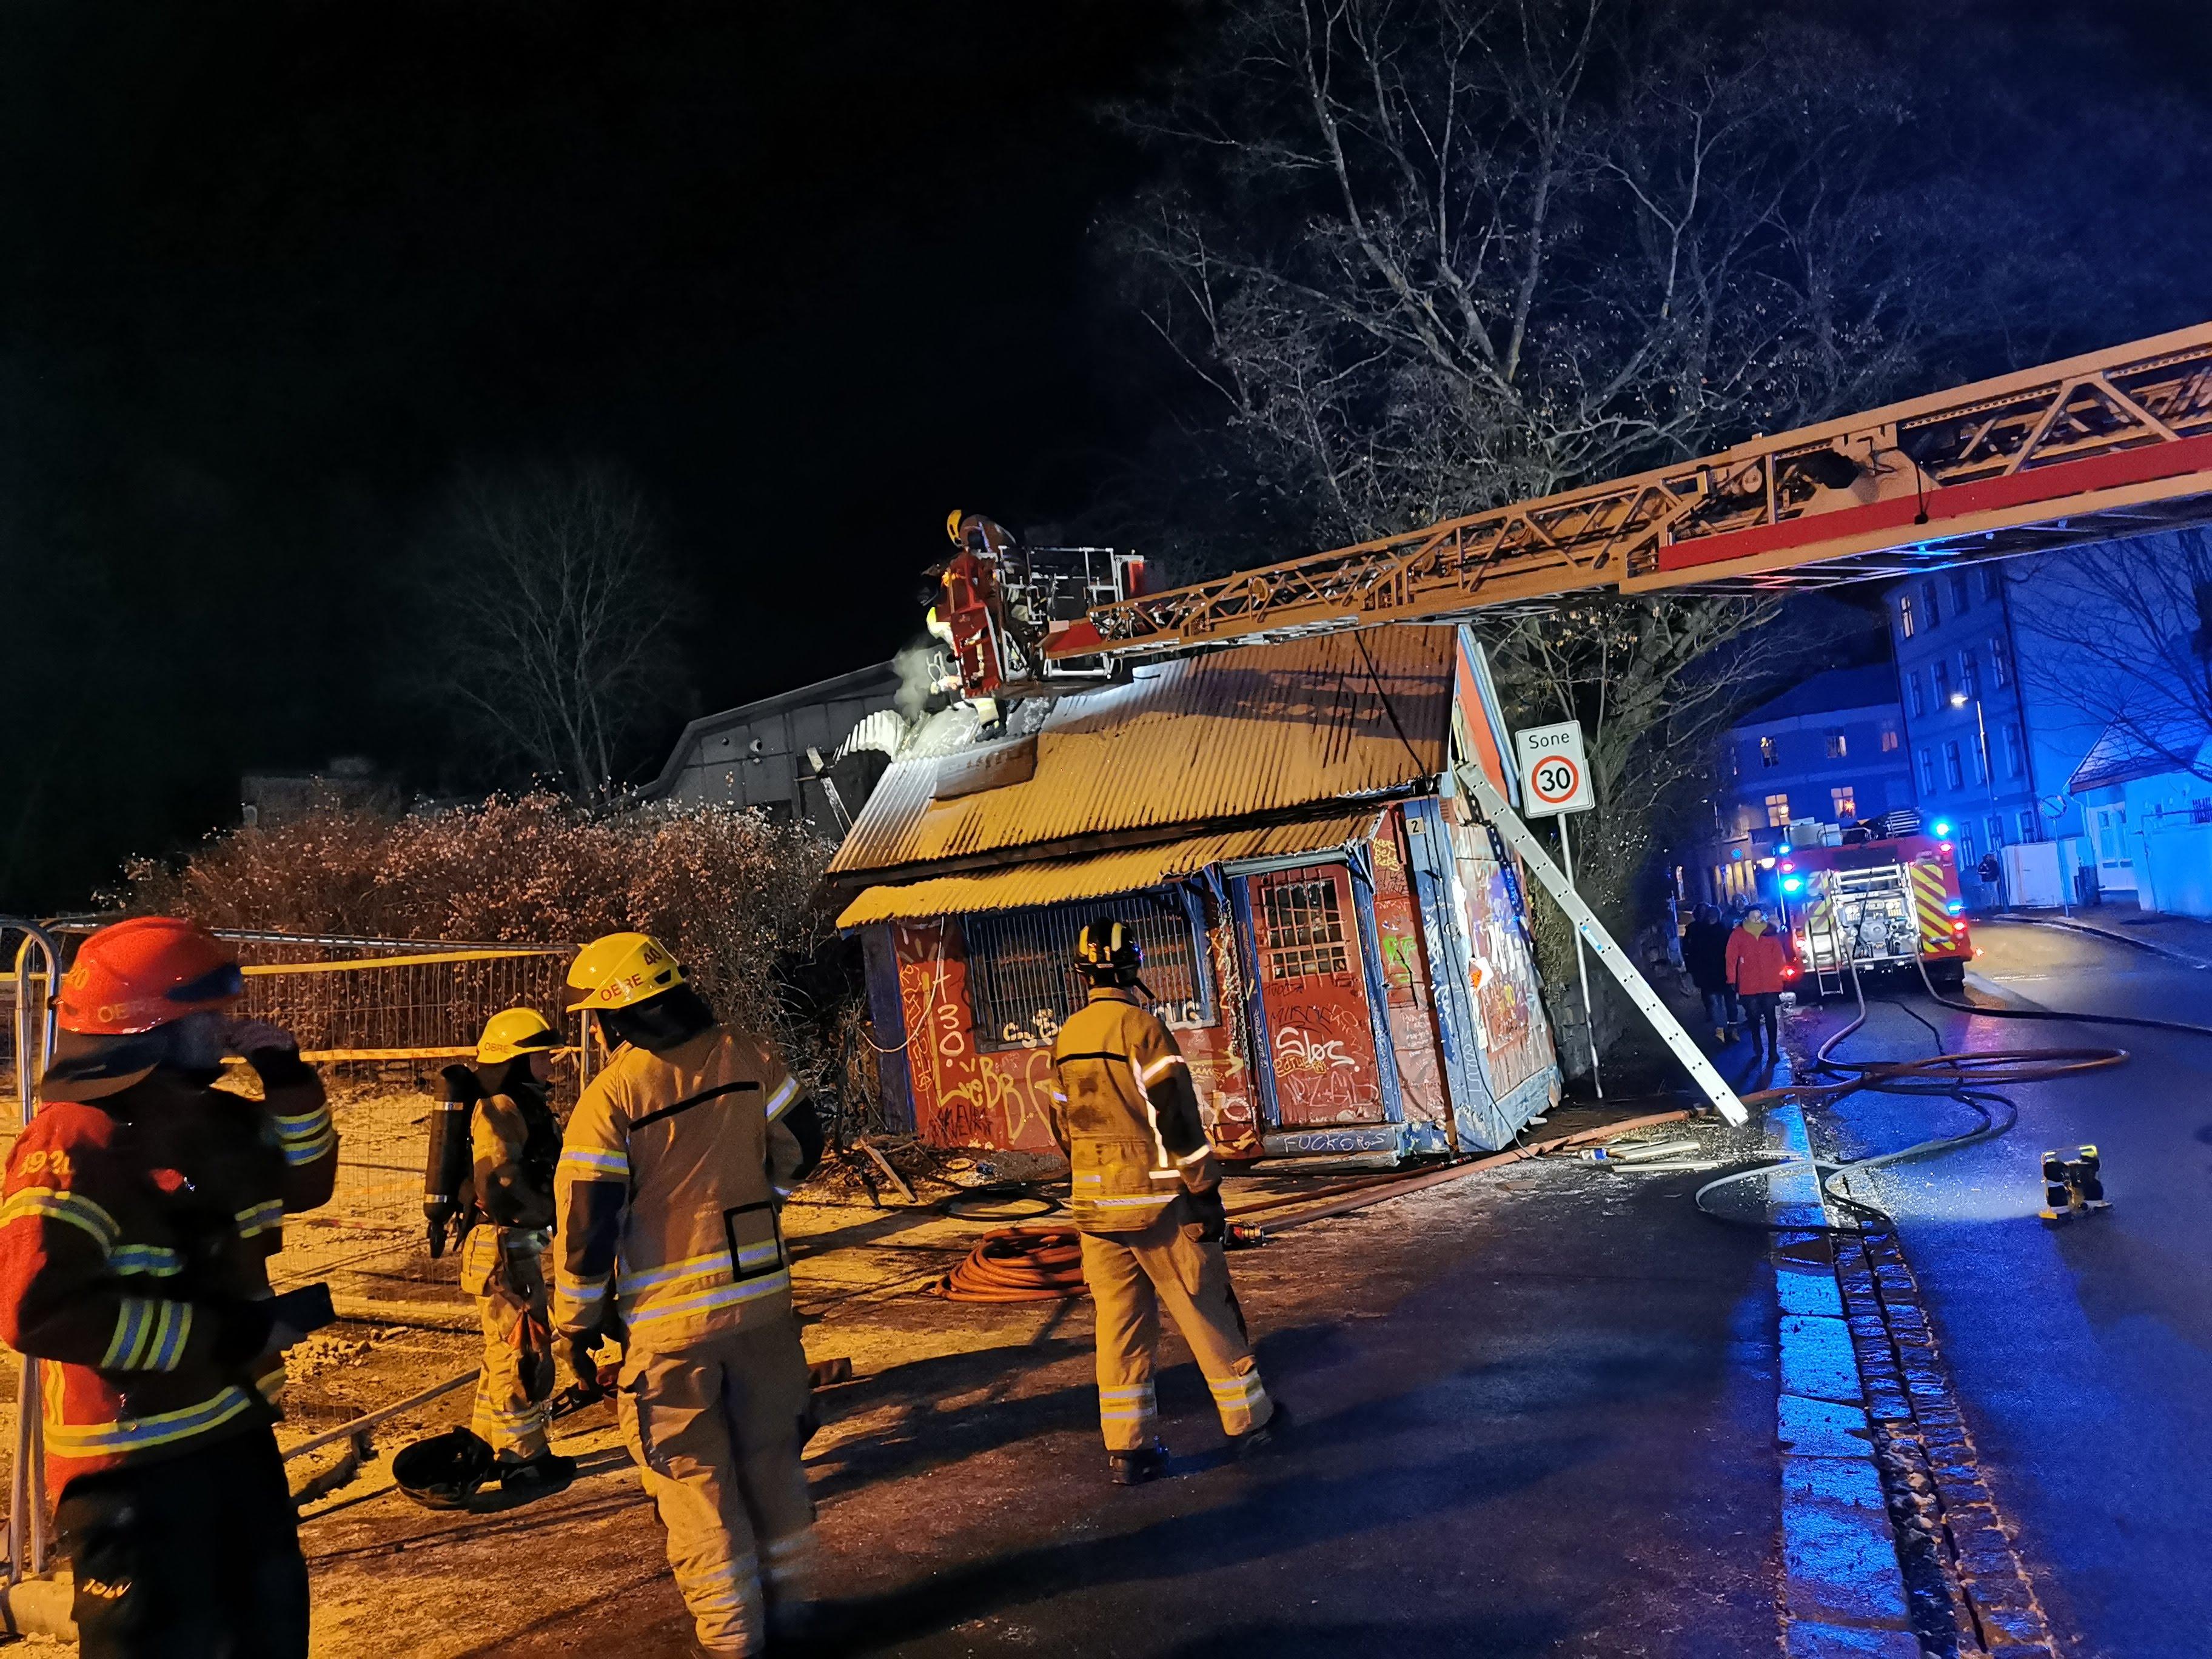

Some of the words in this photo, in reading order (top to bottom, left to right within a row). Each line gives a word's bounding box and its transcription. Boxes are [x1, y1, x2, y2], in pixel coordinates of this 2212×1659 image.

[1529, 733, 1570, 749] Sone
[1540, 767, 1570, 792] 30
[1411, 820, 1419, 833] 2
[643, 947, 662, 966] 40
